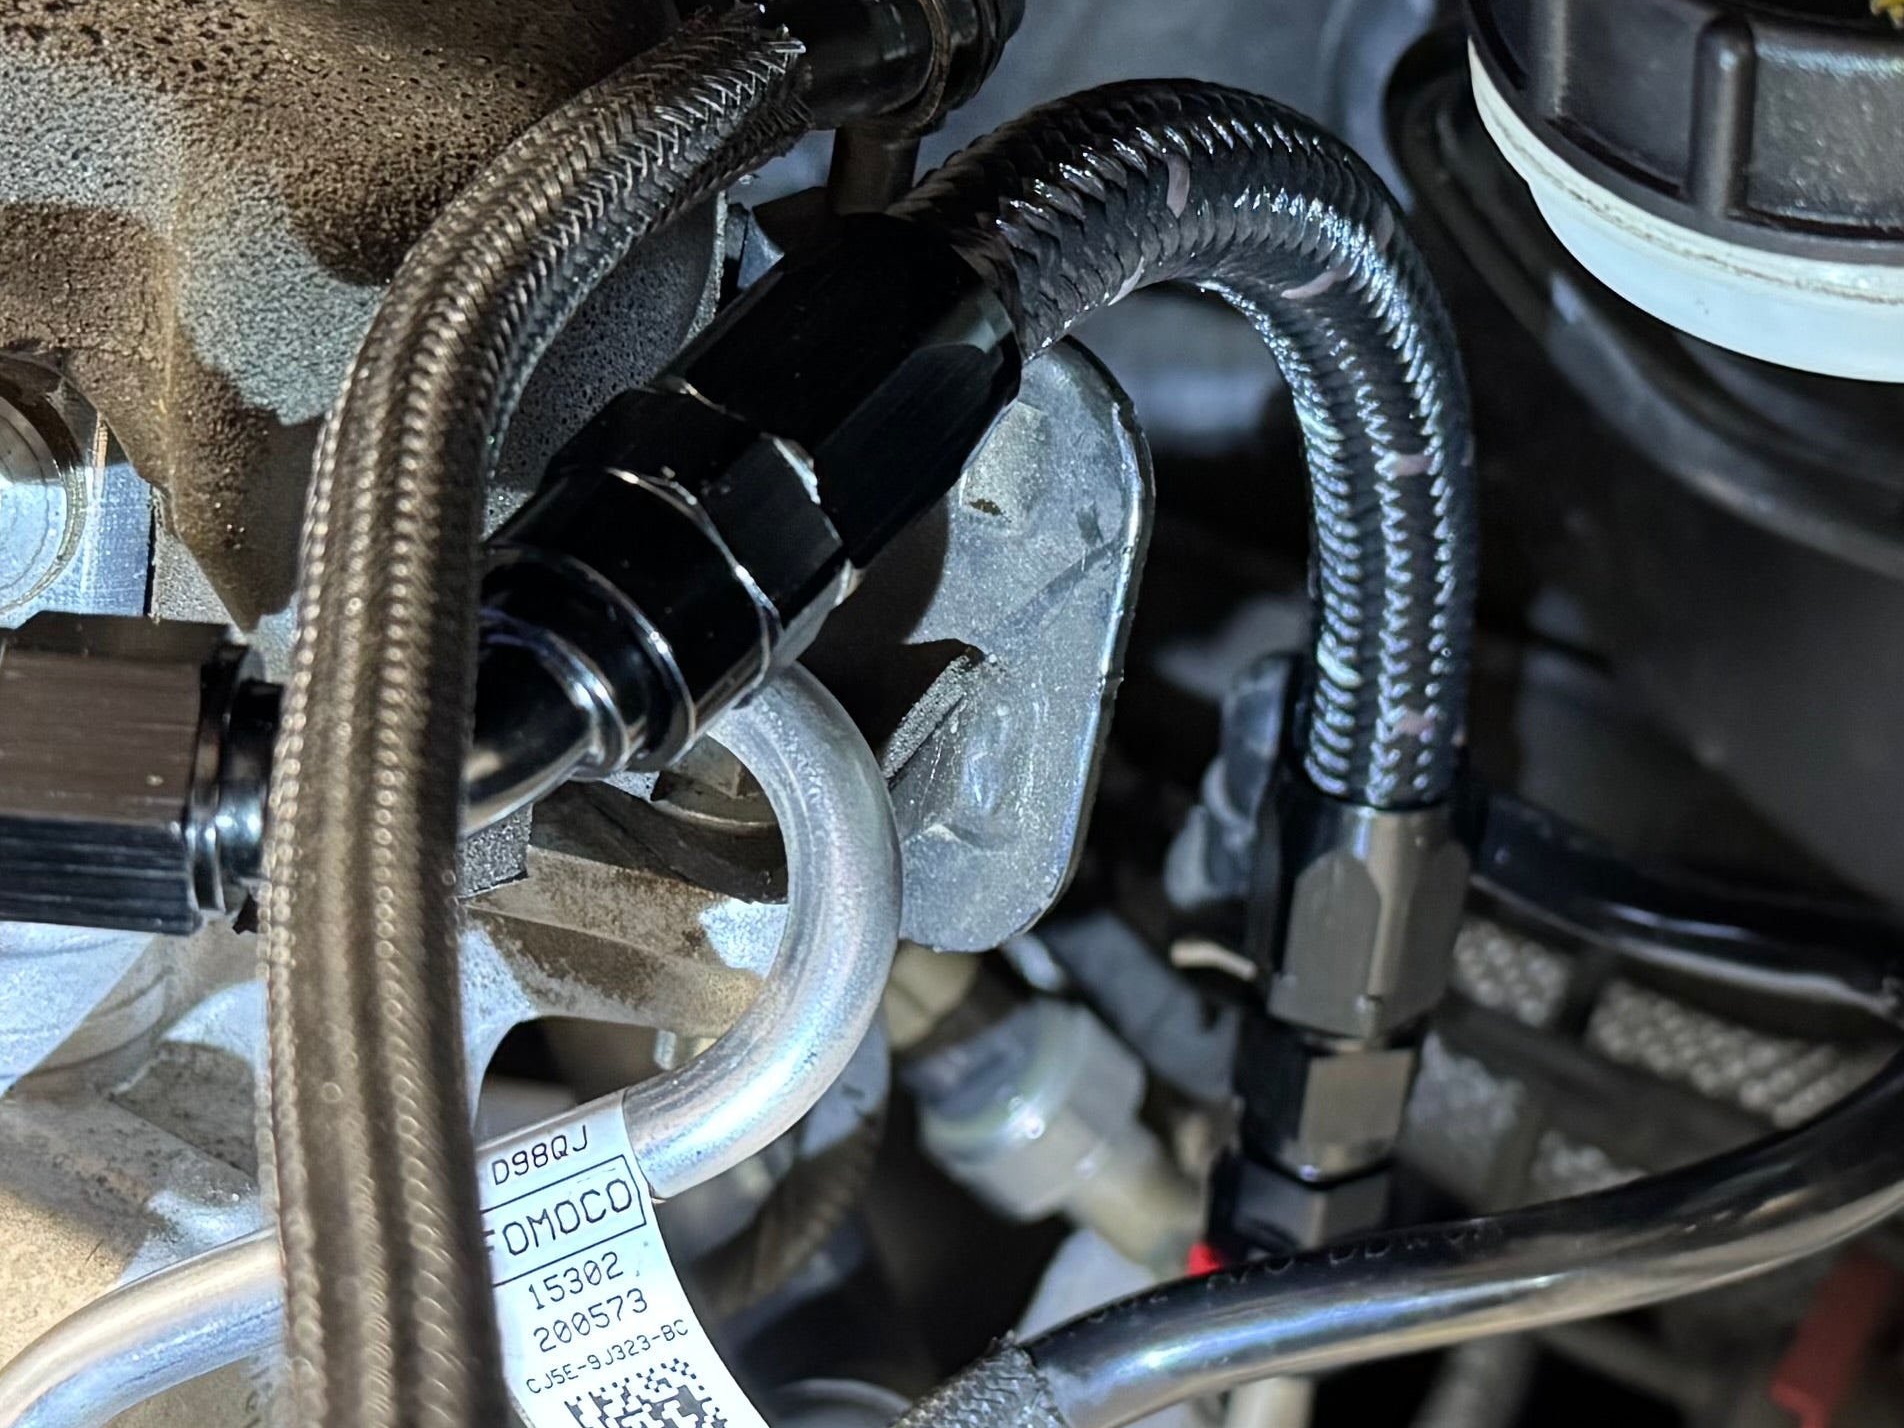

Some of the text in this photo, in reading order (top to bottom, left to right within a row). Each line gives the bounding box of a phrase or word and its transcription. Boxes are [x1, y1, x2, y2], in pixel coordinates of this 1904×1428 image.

[491, 1124, 590, 1186] D98QJ
[482, 1178, 633, 1256] OMOCO
[527, 1251, 625, 1310] 15302
[533, 1287, 649, 1353] 200573
[525, 1318, 690, 1395] CJ5E-9J323-BC
